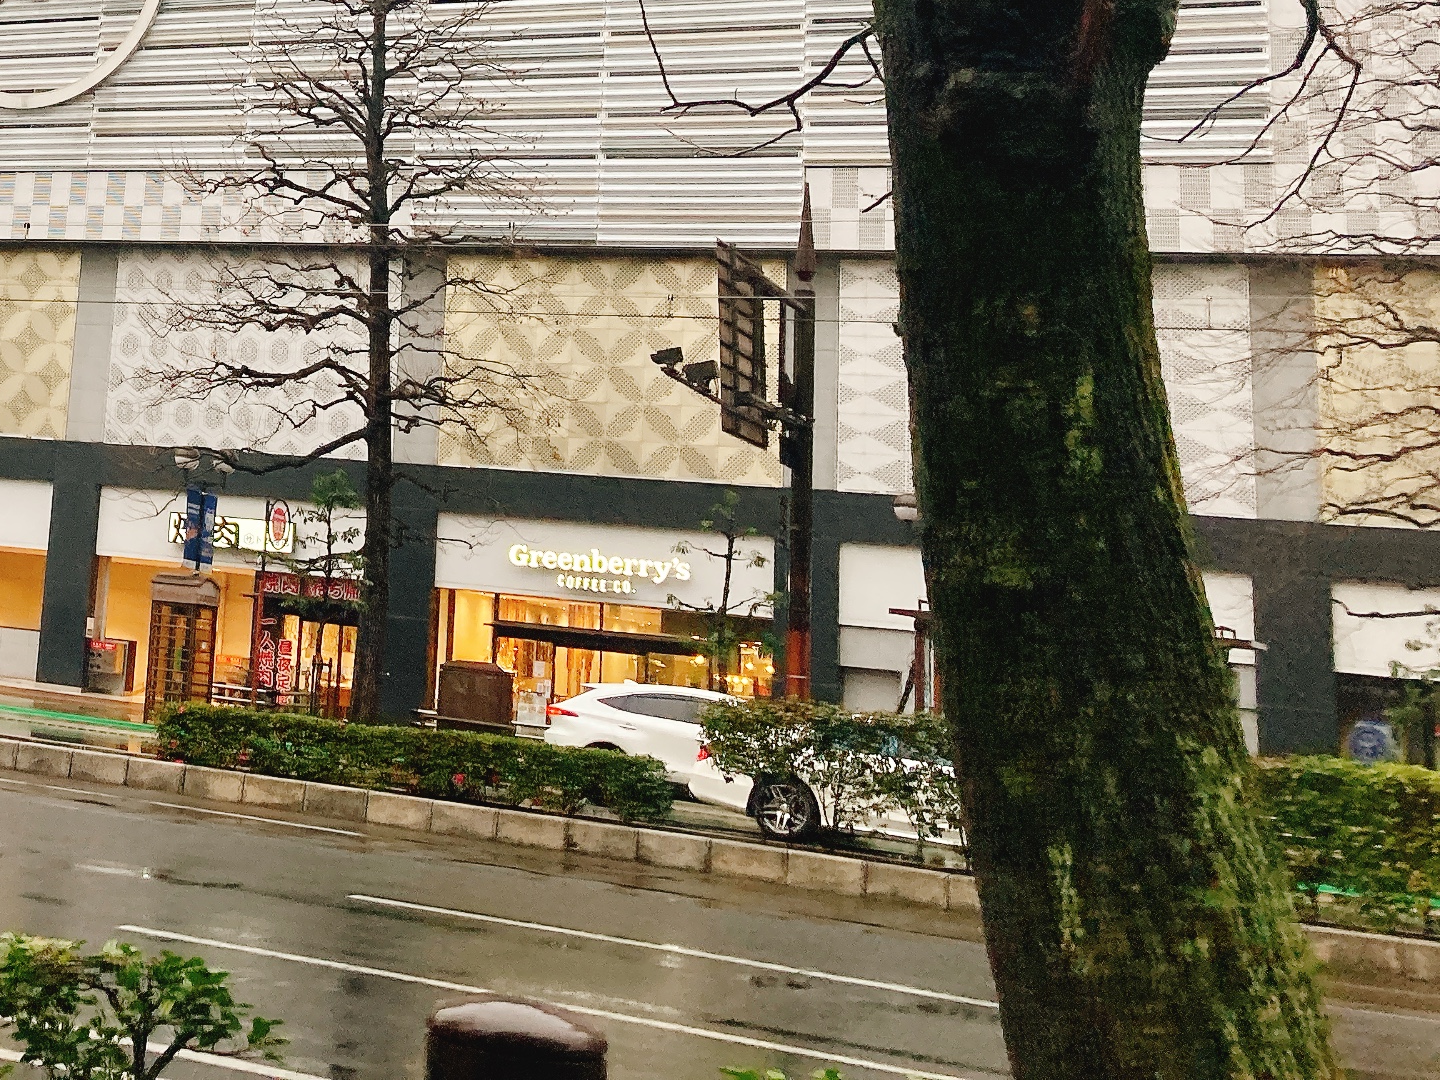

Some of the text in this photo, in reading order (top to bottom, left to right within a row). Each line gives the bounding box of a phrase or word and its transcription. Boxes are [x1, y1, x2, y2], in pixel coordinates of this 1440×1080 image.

[508, 543, 692, 585] Greenberry's
[556, 572, 638, 595] COFFEE CO.
